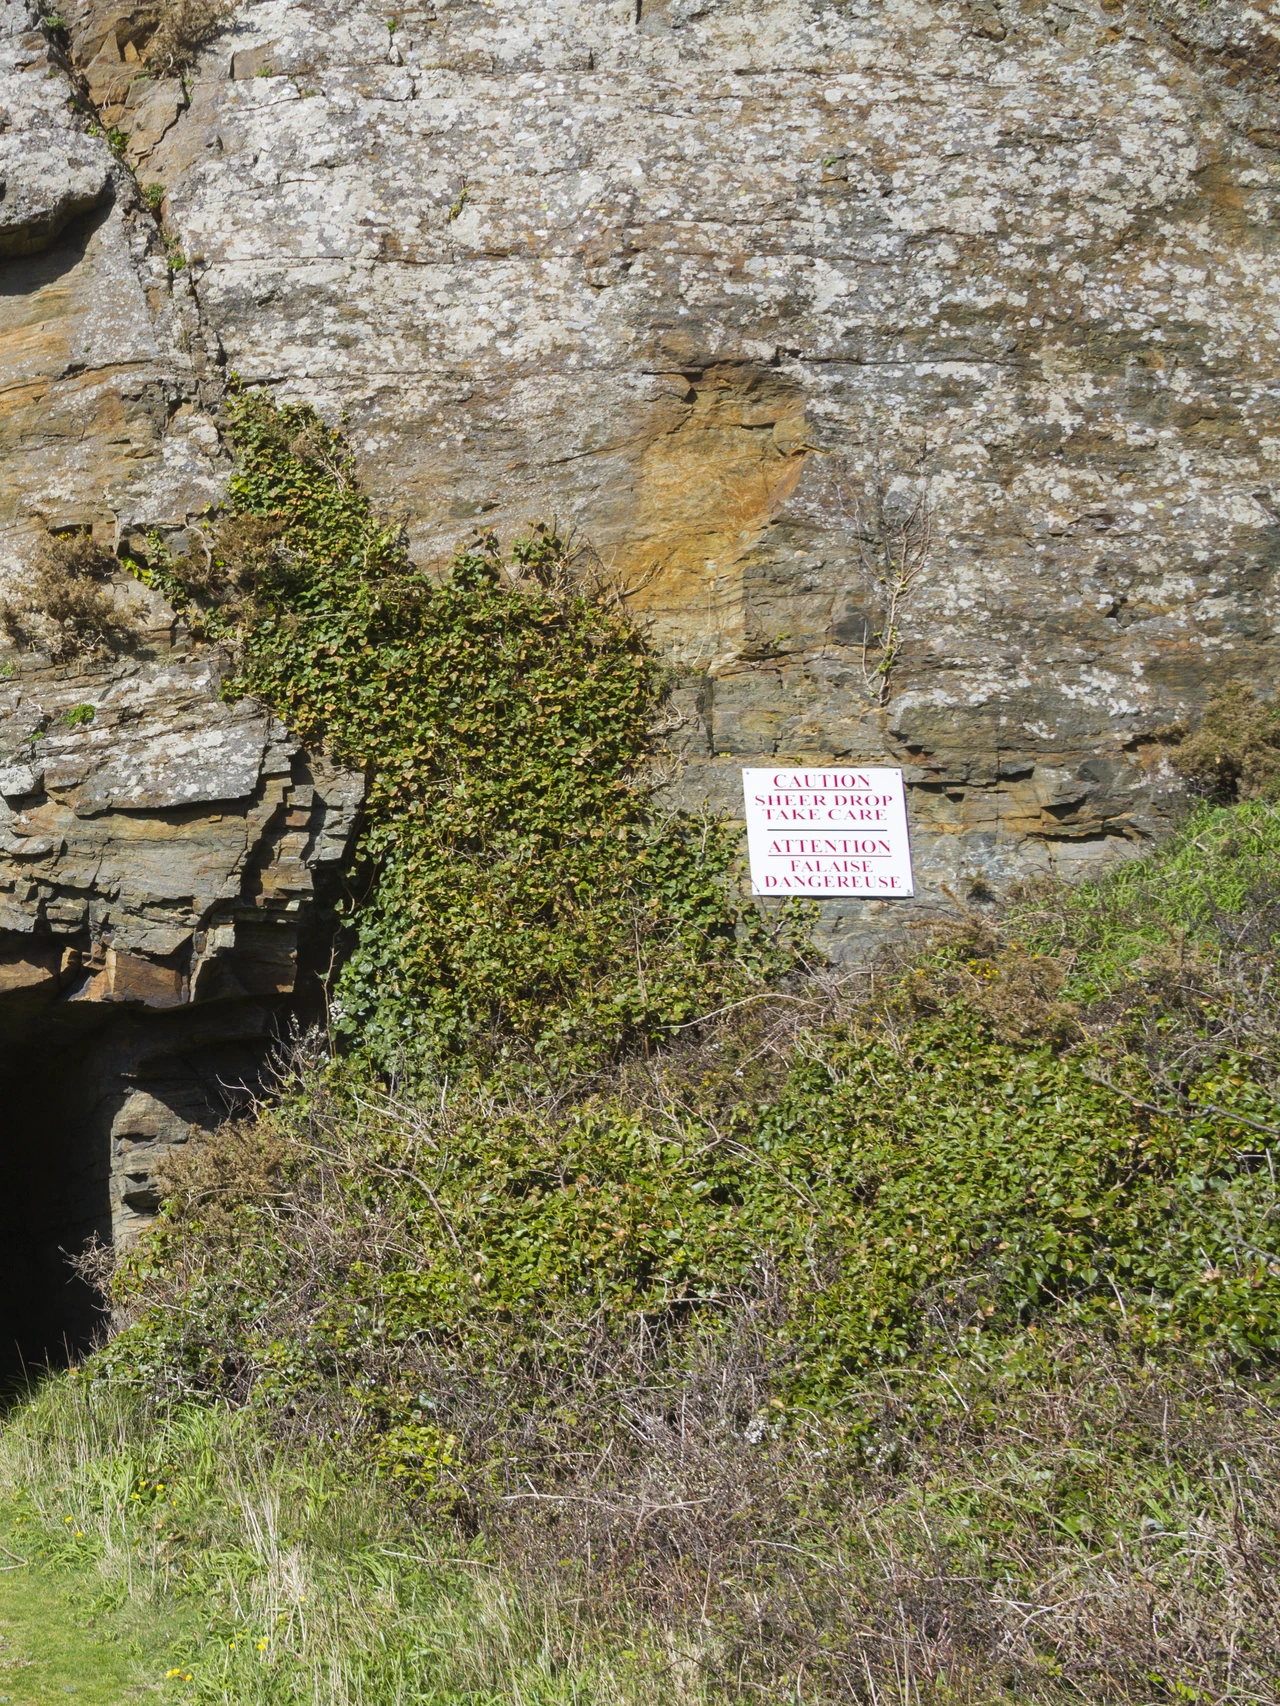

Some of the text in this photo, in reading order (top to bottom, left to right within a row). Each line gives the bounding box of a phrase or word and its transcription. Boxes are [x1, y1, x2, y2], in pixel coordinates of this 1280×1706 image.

[773, 774, 870, 788] CAUTION
[754, 795, 893, 807] SHEER DROP
[762, 809, 888, 821] TAKE CARE
[768, 839, 891, 853] ATTENTION
[790, 860, 874, 873] FALAISE
[764, 875, 902, 888] DANGEREUSE
